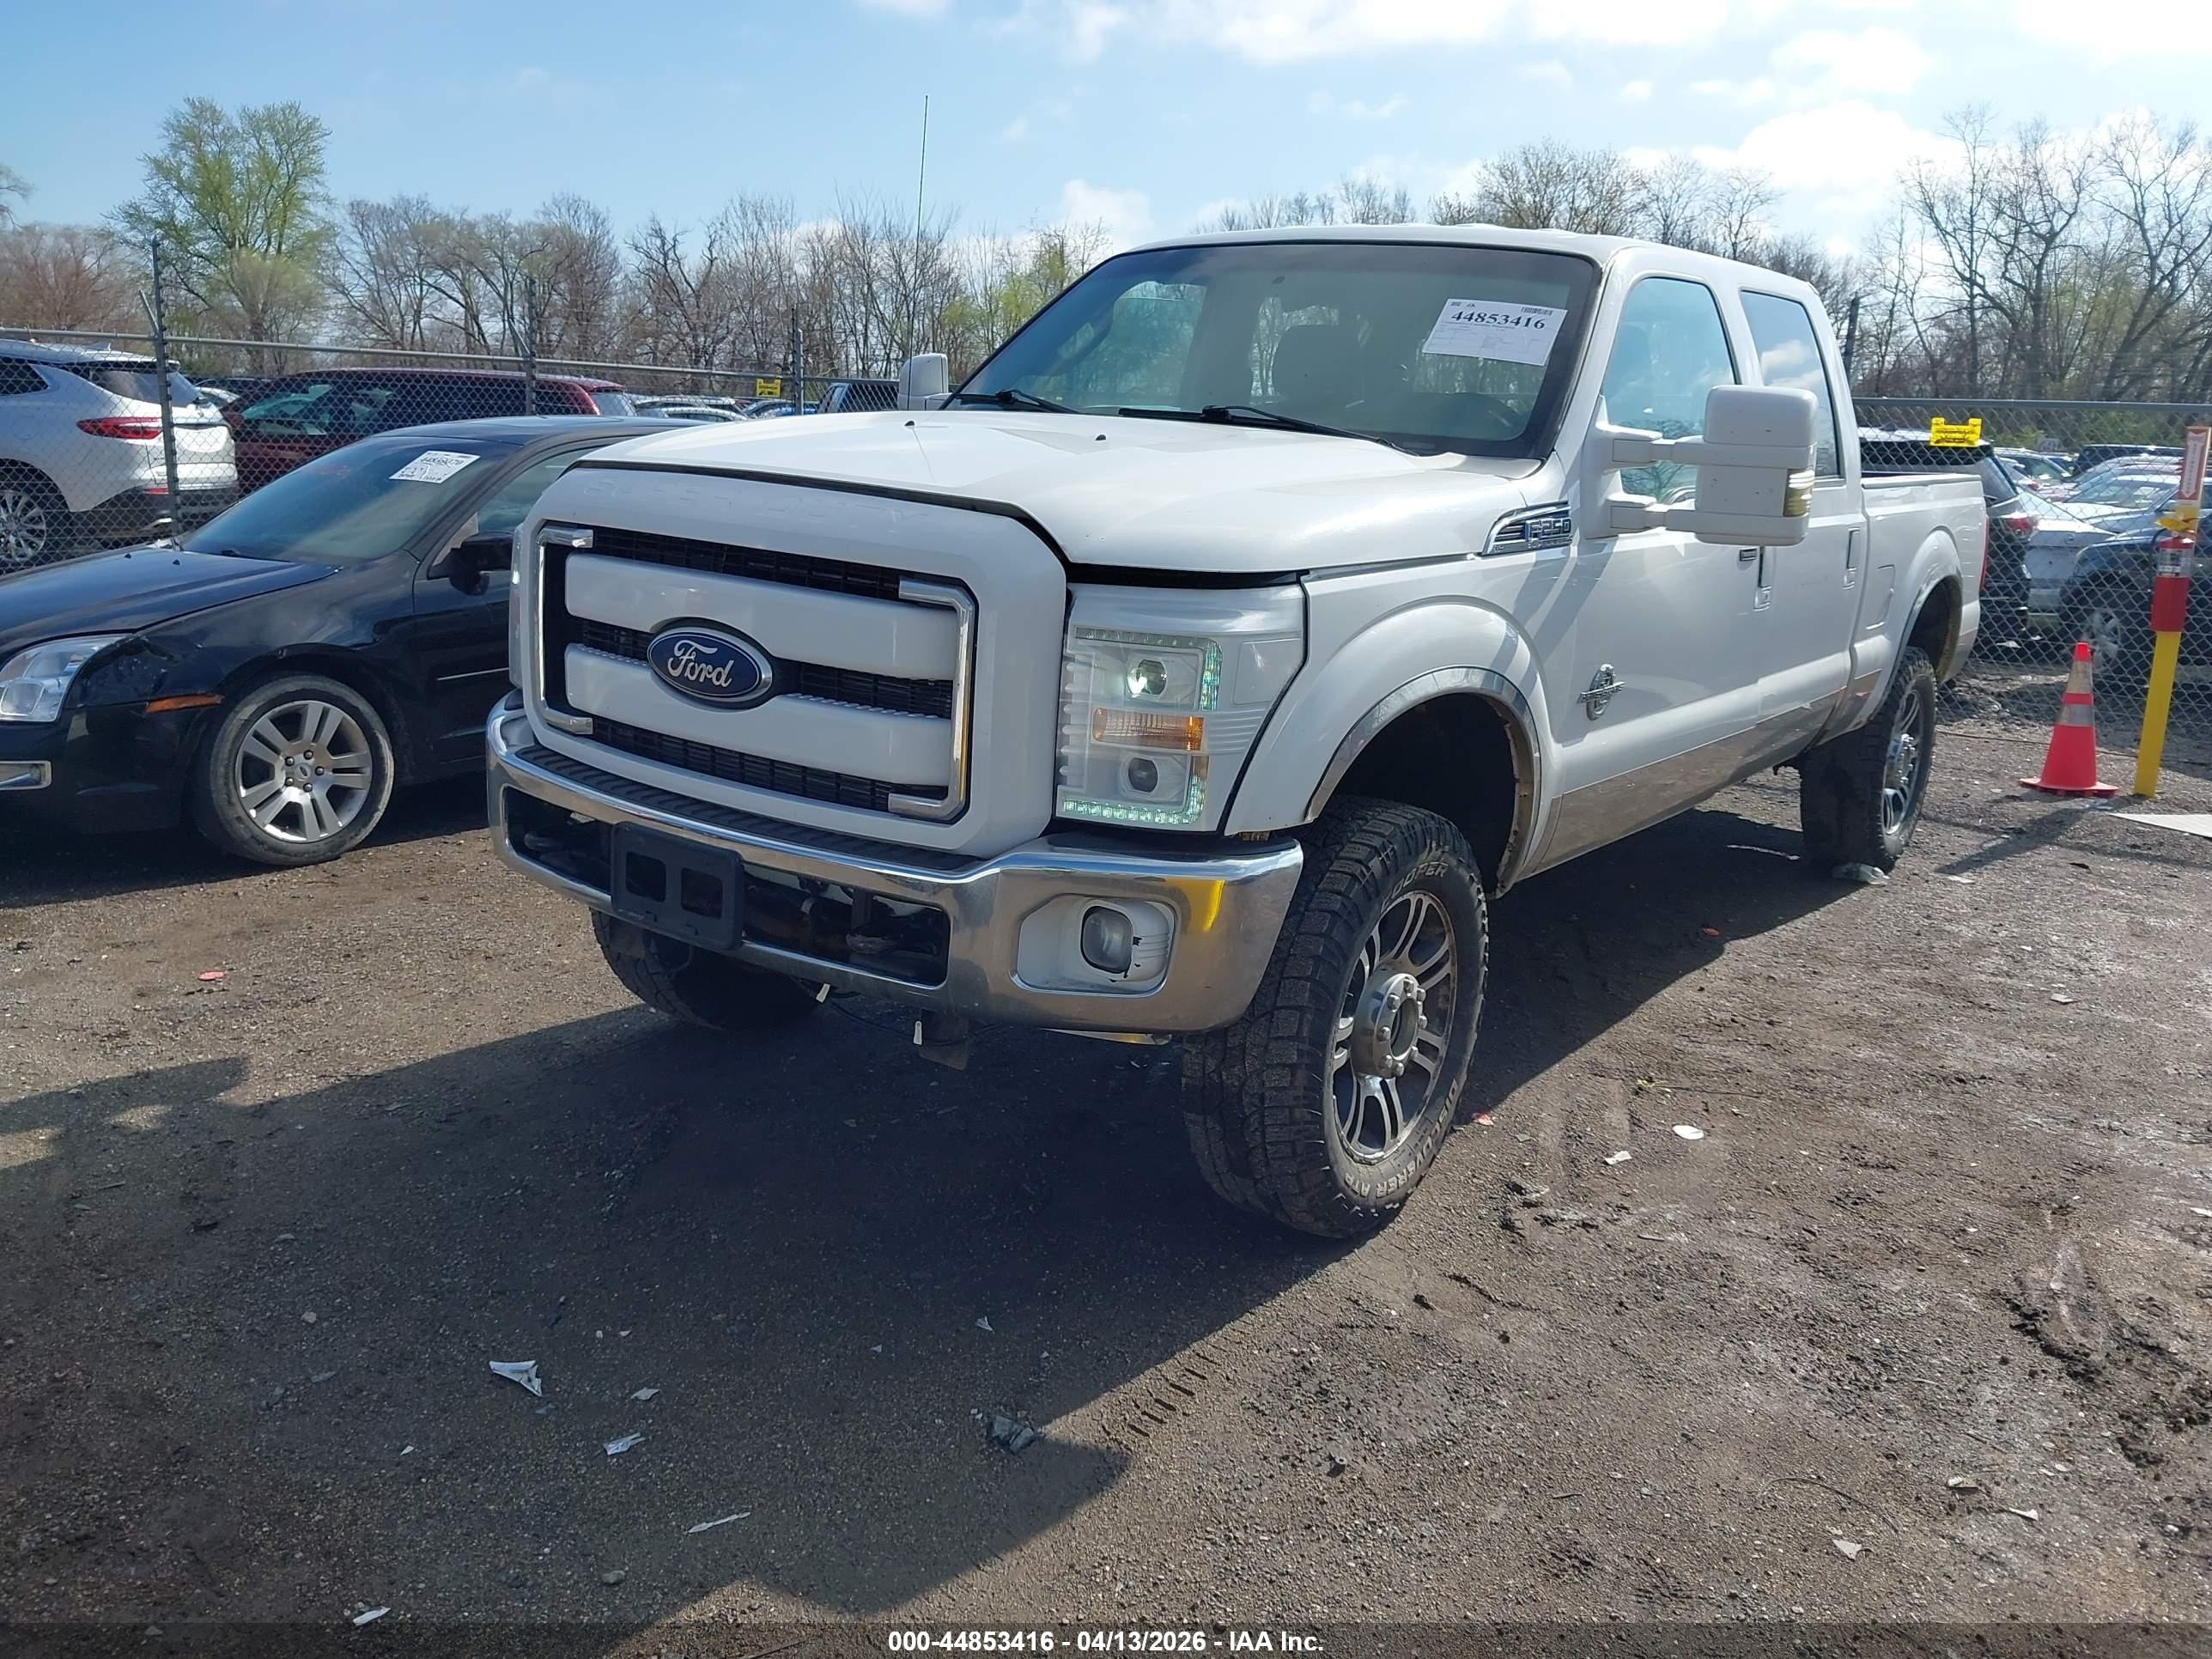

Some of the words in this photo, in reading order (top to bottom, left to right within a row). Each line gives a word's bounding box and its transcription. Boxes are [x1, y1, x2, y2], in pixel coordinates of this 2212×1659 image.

[1451, 310, 1547, 331] 44853416
[667, 639, 735, 688] Ford
[1380, 860, 1449, 914] COOPER
